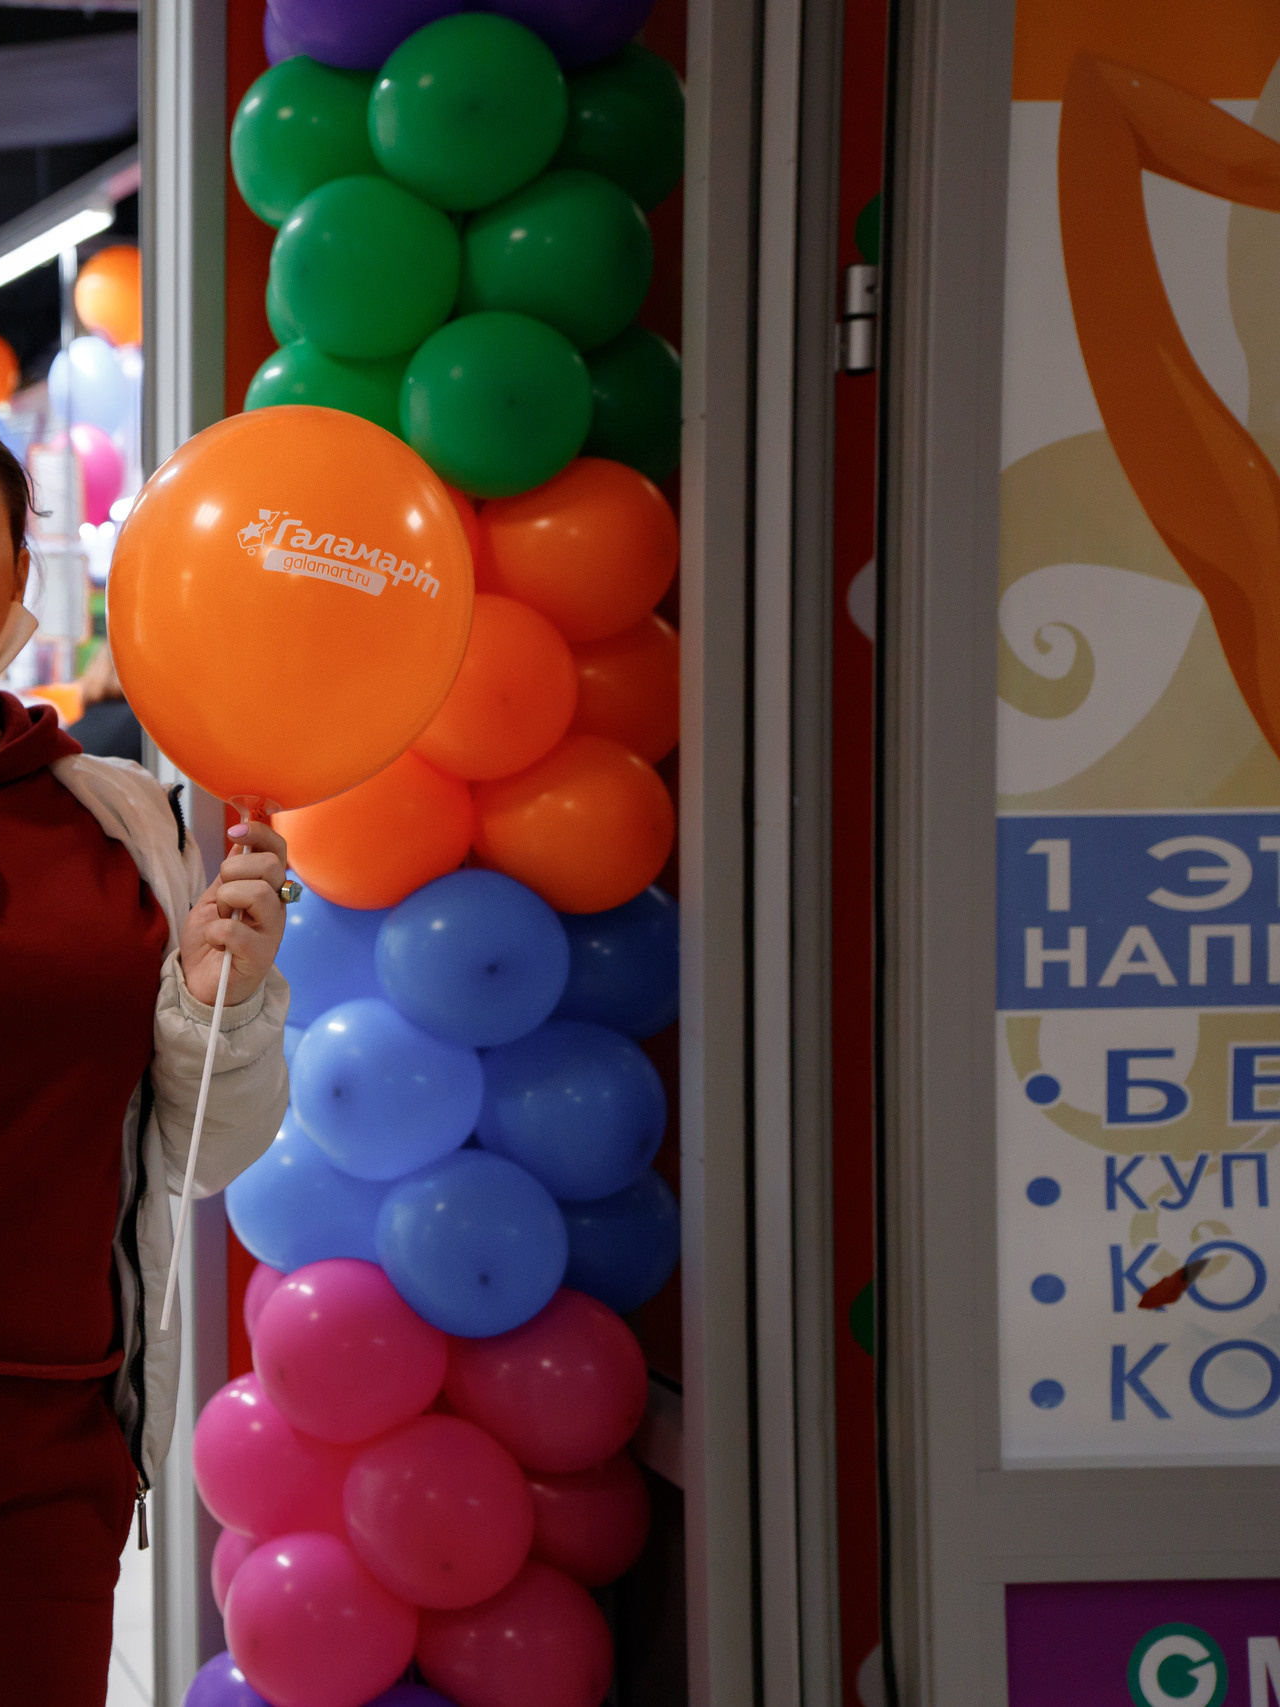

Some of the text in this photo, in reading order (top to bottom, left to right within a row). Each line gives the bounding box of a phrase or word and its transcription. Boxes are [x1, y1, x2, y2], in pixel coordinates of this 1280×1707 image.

[272, 518, 440, 599] Галамарт
[282, 555, 372, 588] galamart.ru
[1025, 834, 1280, 913] 1 Э
[1024, 923, 1280, 989] НАП
[1105, 1152, 1269, 1212] КУП
[1109, 1240, 1267, 1313] КО
[1111, 1339, 1280, 1421] КО
